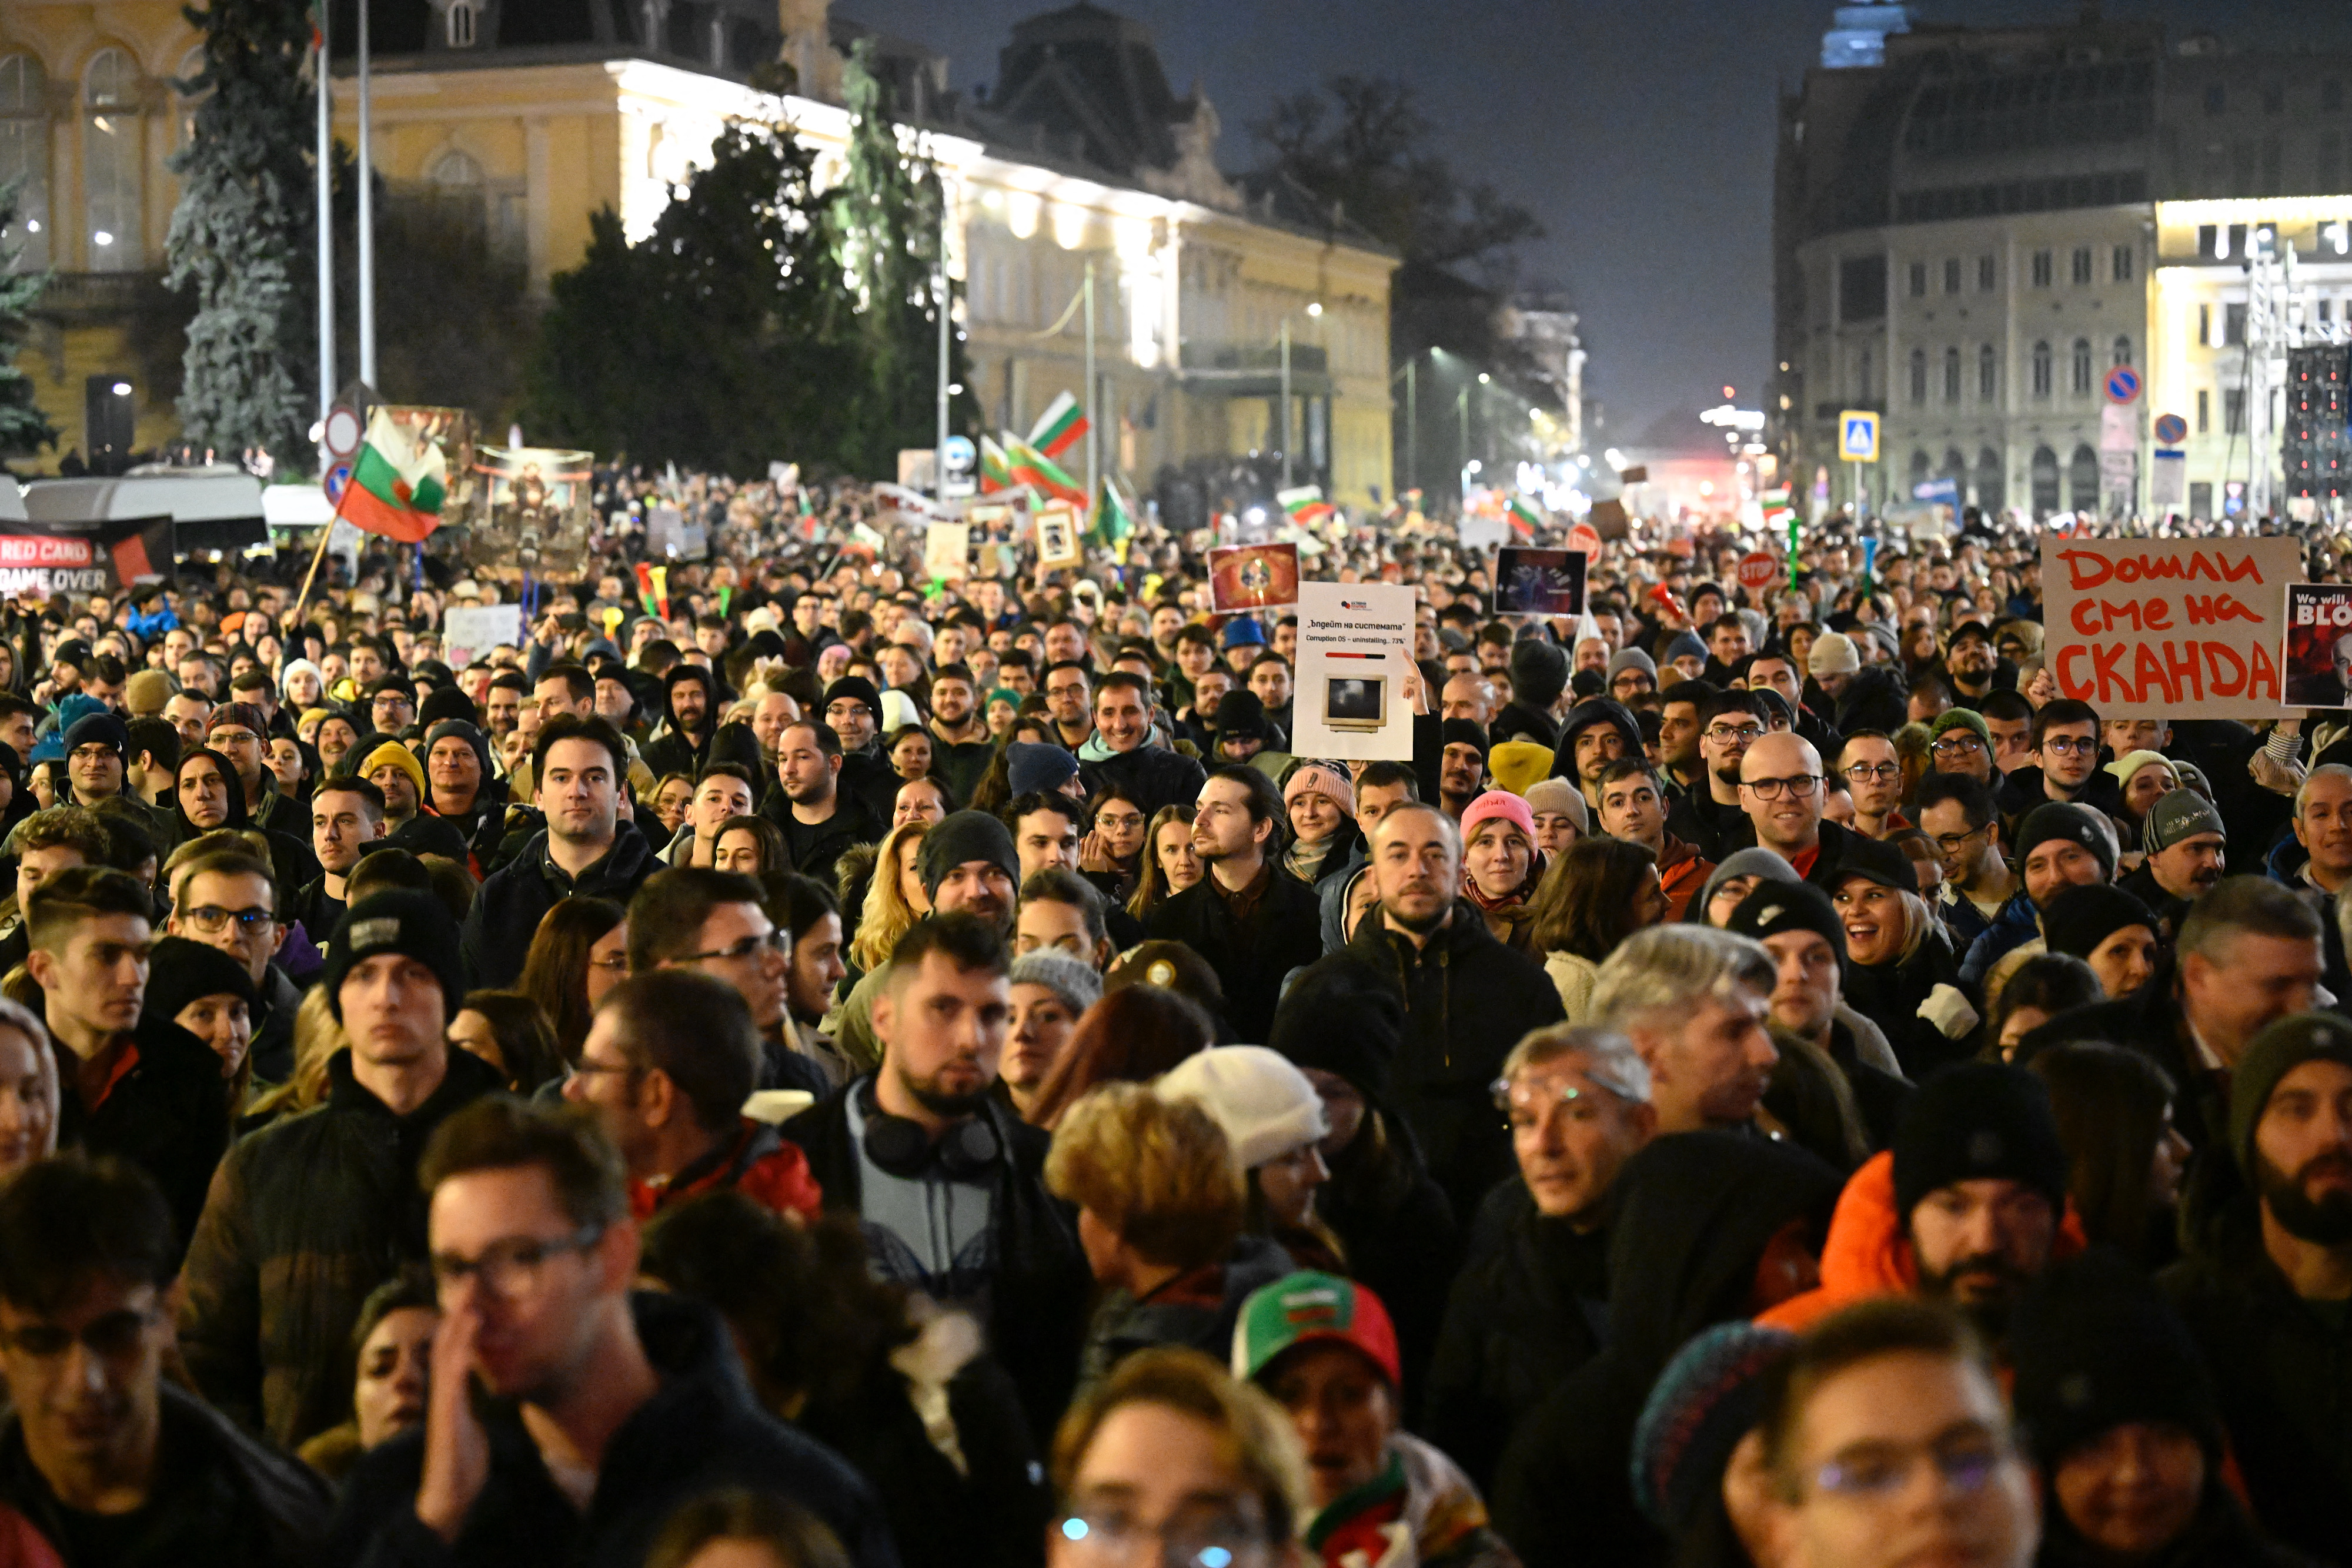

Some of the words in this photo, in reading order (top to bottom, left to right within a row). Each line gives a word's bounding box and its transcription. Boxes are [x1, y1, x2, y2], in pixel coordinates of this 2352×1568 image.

[1, 540, 36, 560] RED
[40, 541, 88, 561] CARD
[54, 568, 106, 591] OVER
[1741, 560, 1773, 579] STOP
[2184, 593, 2266, 625] на
[2296, 593, 2317, 604] We
[1306, 634, 1337, 643] Corruption
[2056, 640, 2285, 704] СКАНДА
